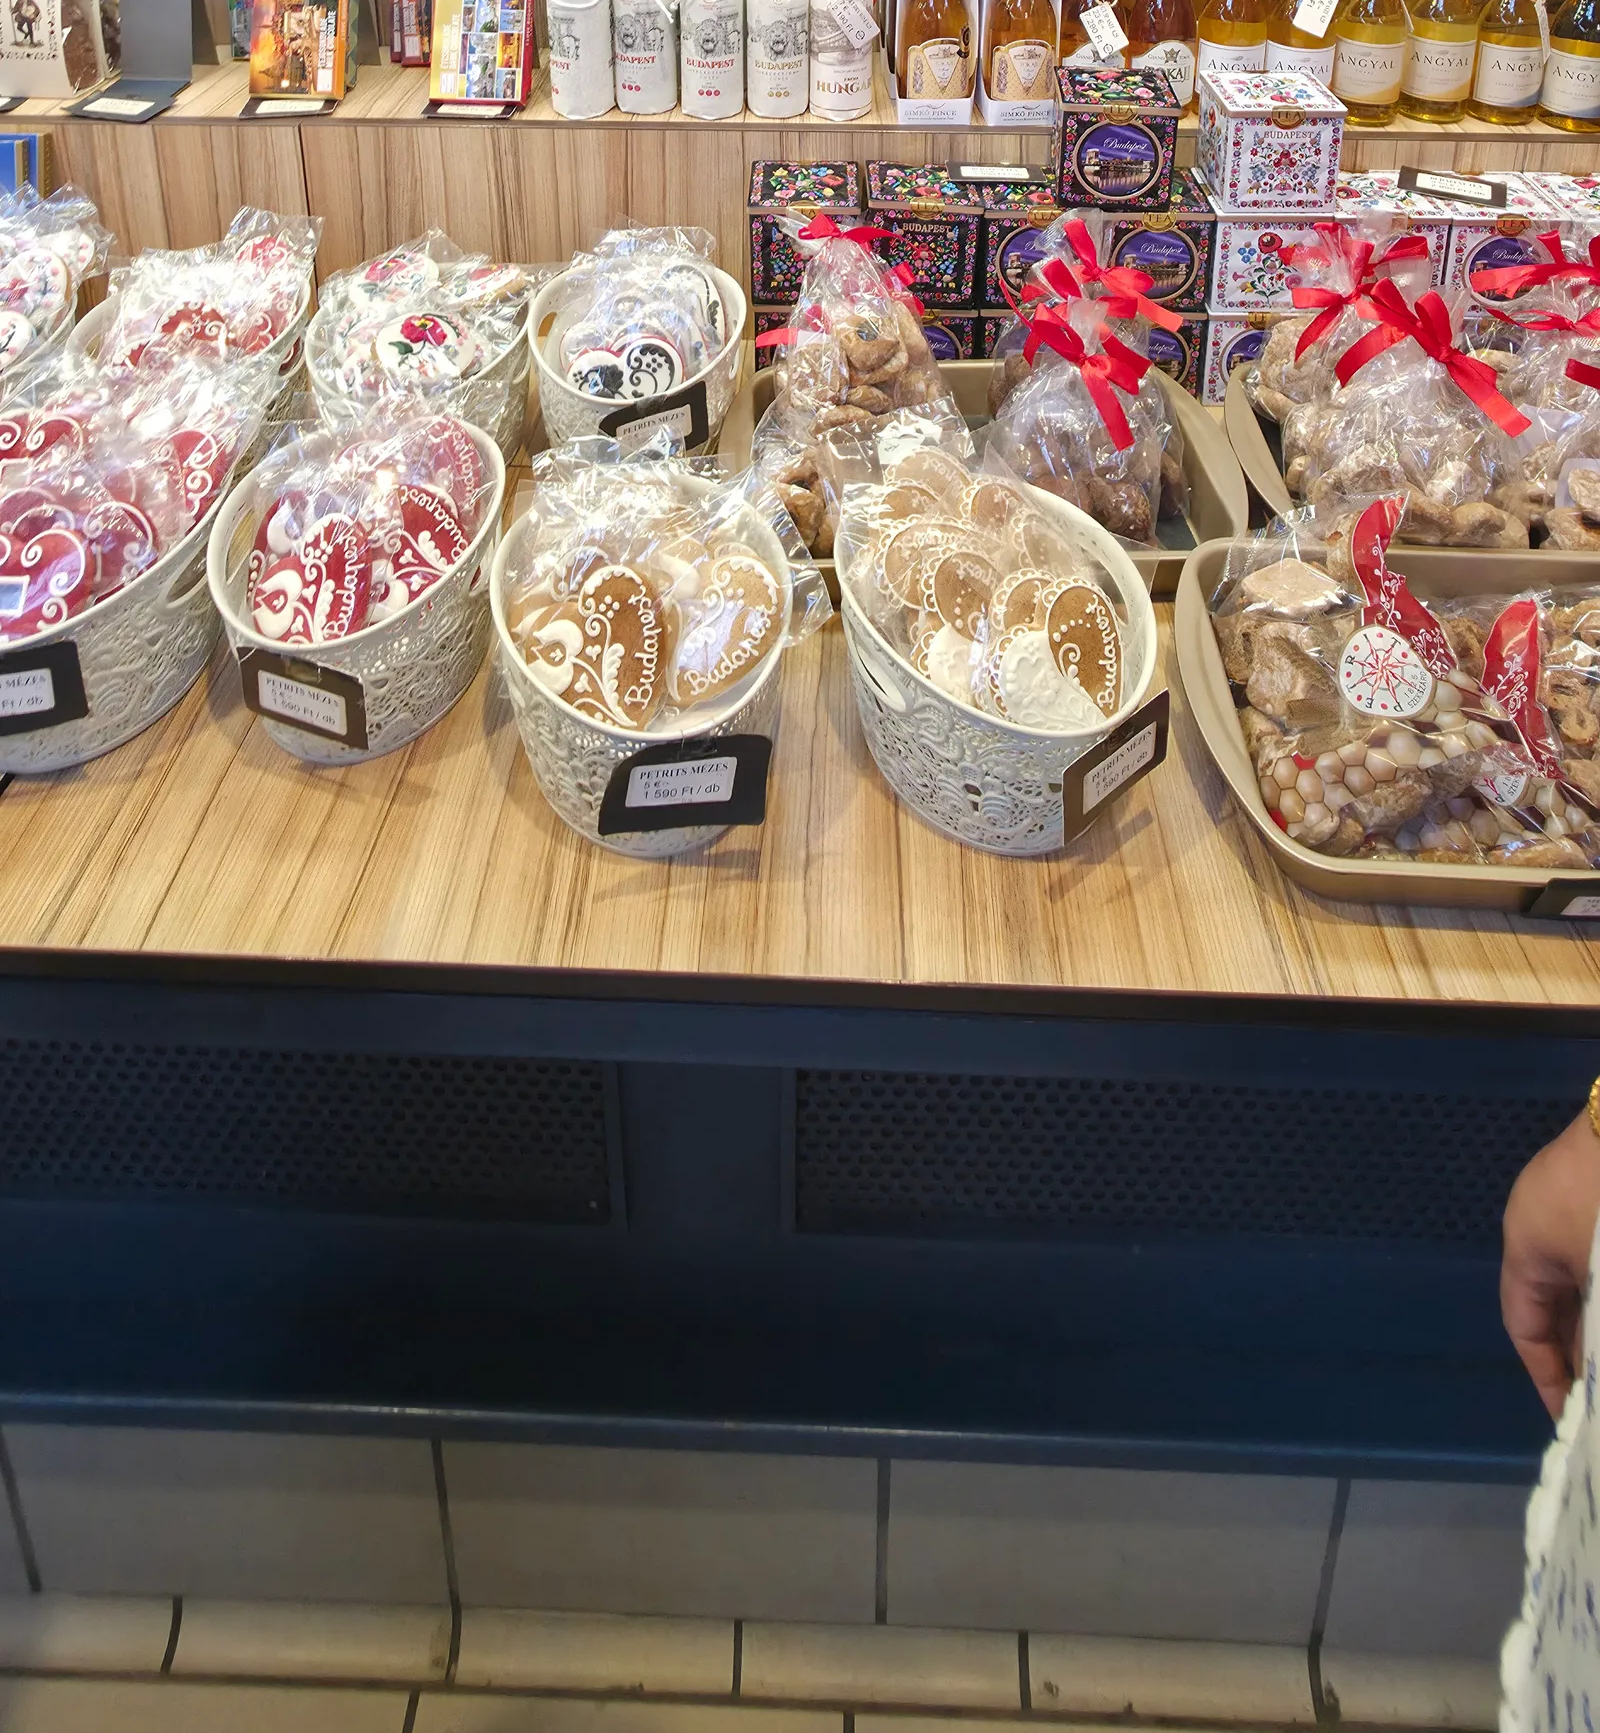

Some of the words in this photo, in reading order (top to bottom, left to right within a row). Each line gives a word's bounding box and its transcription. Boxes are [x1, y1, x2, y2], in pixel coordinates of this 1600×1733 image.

[686, 57, 735, 69] BUDAPEST
[755, 59, 803, 70] BUDAPEST
[1337, 53, 1395, 70] ANGYAL
[1411, 52, 1469, 68] ANGYAL
[1492, 60, 1544, 73] ANGYA
[1552, 66, 1600, 83] ANGY
[1264, 130, 1314, 139] BUDAPEST
[1103, 137, 1148, 151] Budapest
[916, 201, 941, 212] TEA
[1033, 209, 1058, 219] TEA
[1148, 213, 1172, 223] TEA
[902, 223, 952, 234] BUDAPEST
[1140, 244, 1183, 256] Budapest
[400, 484, 470, 559] Budapest
[323, 533, 368, 641] Budapest
[623, 585, 661, 709] Budapest
[683, 602, 778, 697] Budapest
[1085, 594, 1117, 711] Budapest
[1407, 670, 1427, 709] SZEKSZÁRD
[639, 768, 688, 780] PETRITS
[690, 762, 729, 775] MÉZES
[681, 786, 694, 797] Ft
[705, 782, 721, 794] db
